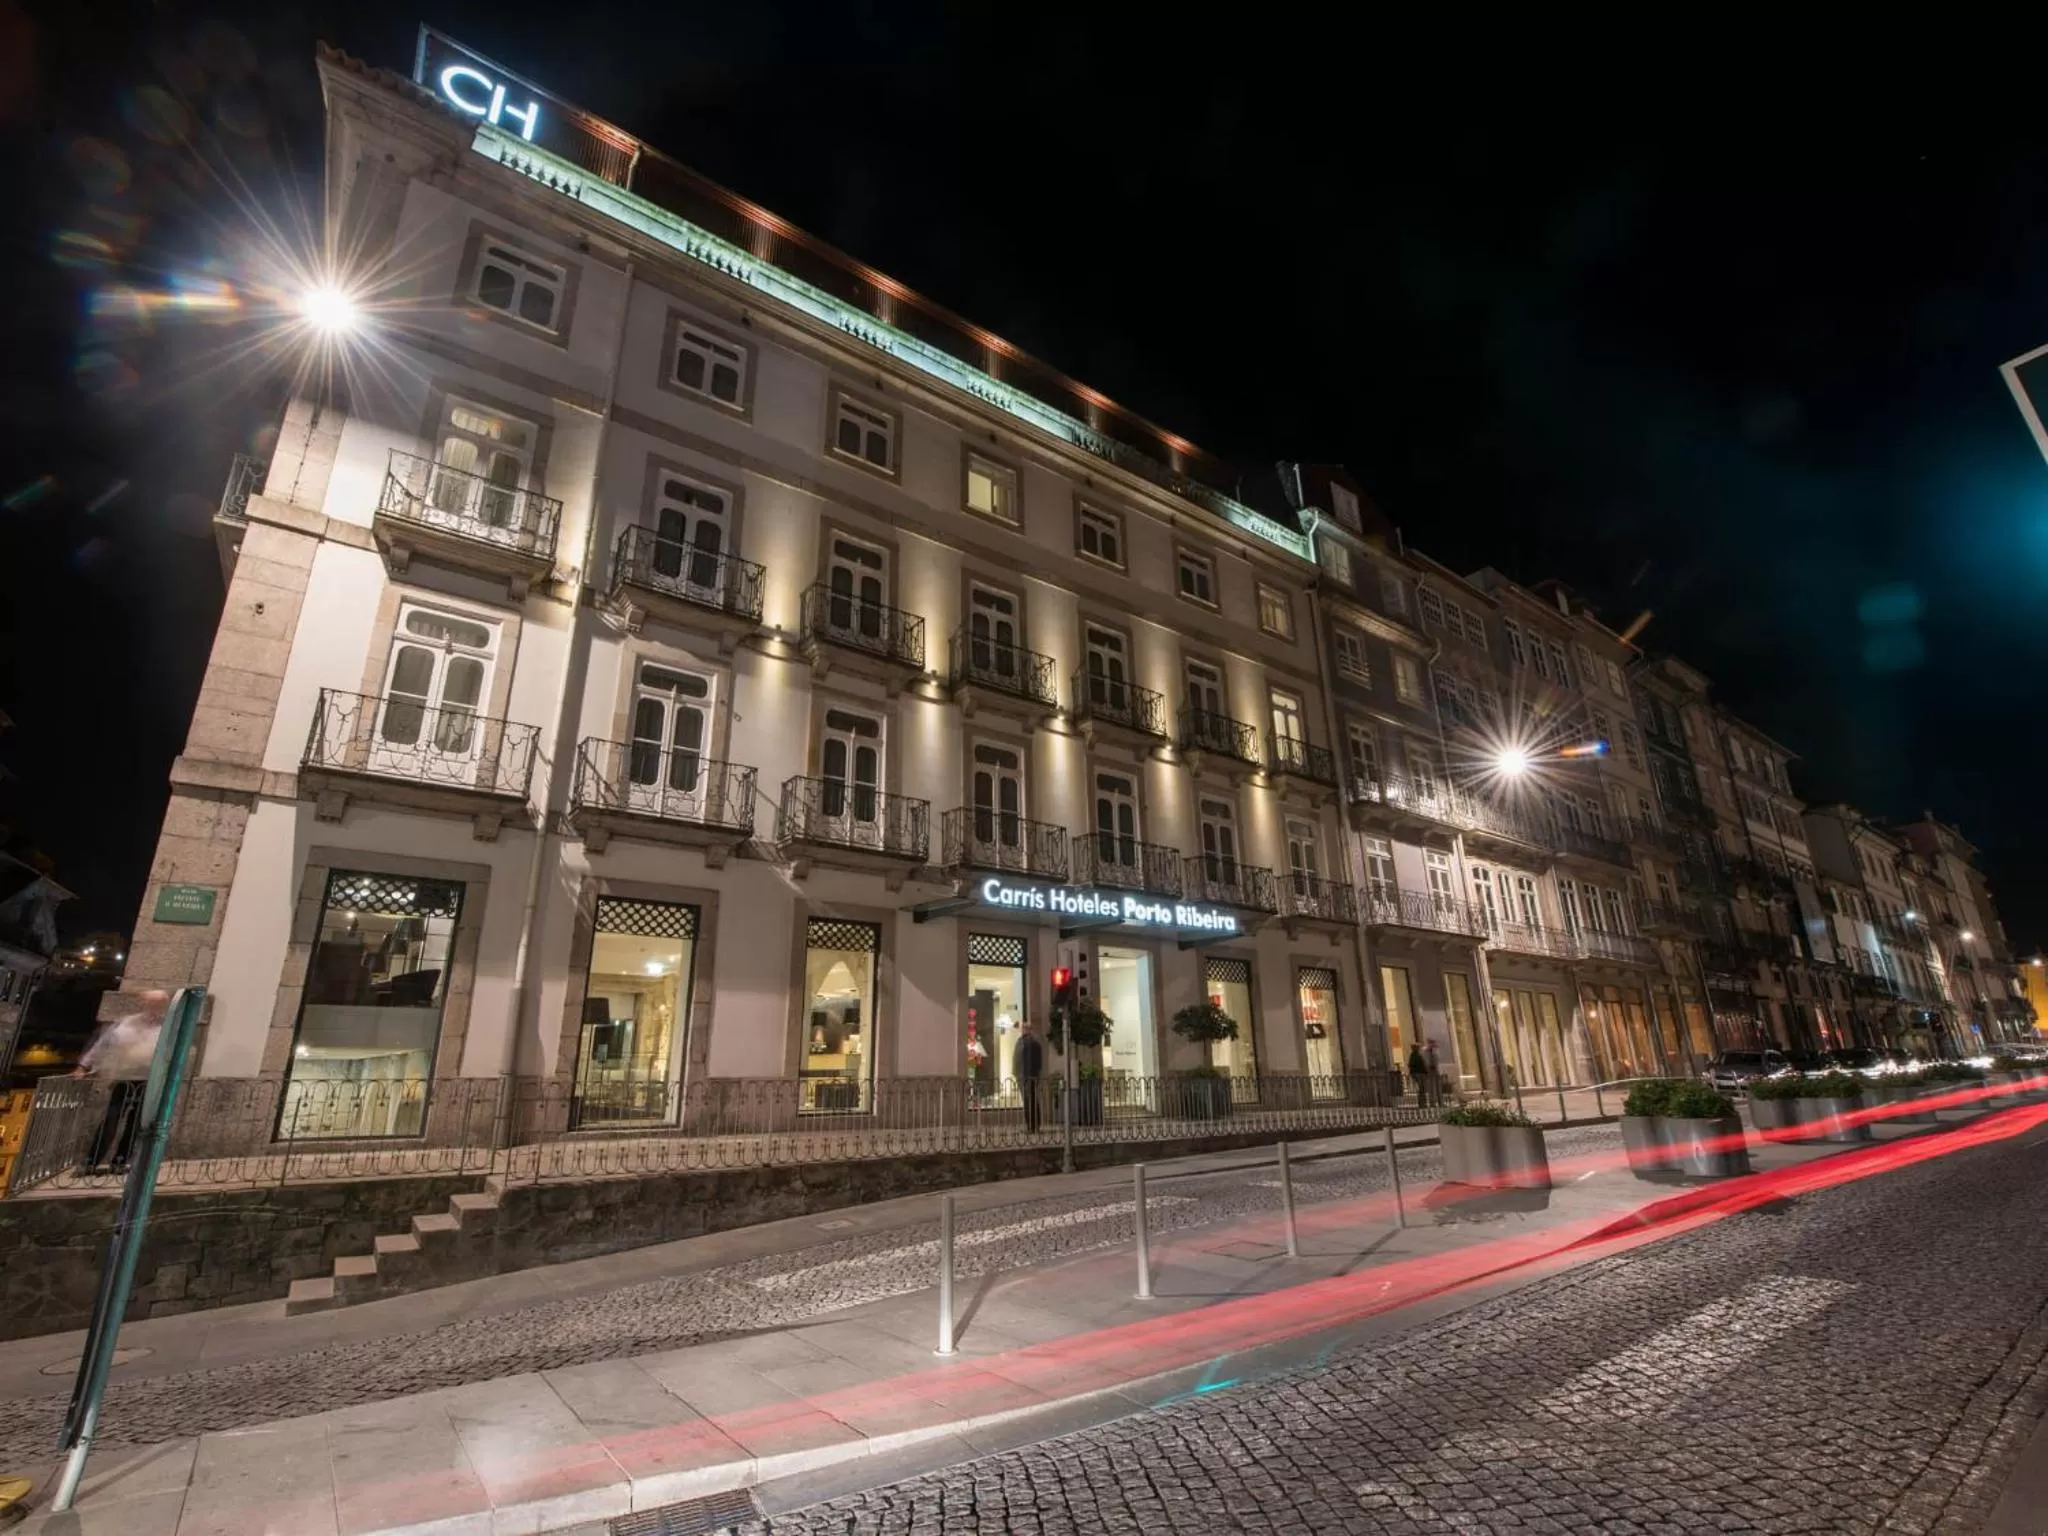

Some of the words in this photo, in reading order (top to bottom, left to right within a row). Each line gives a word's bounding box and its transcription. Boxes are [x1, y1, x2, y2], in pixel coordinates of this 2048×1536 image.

[441, 65, 539, 142] CH
[983, 878, 1045, 909] Carrís
[1050, 888, 1119, 917] Hoteles
[1124, 896, 1172, 924] Porto
[1175, 905, 1236, 931] Ribeira
